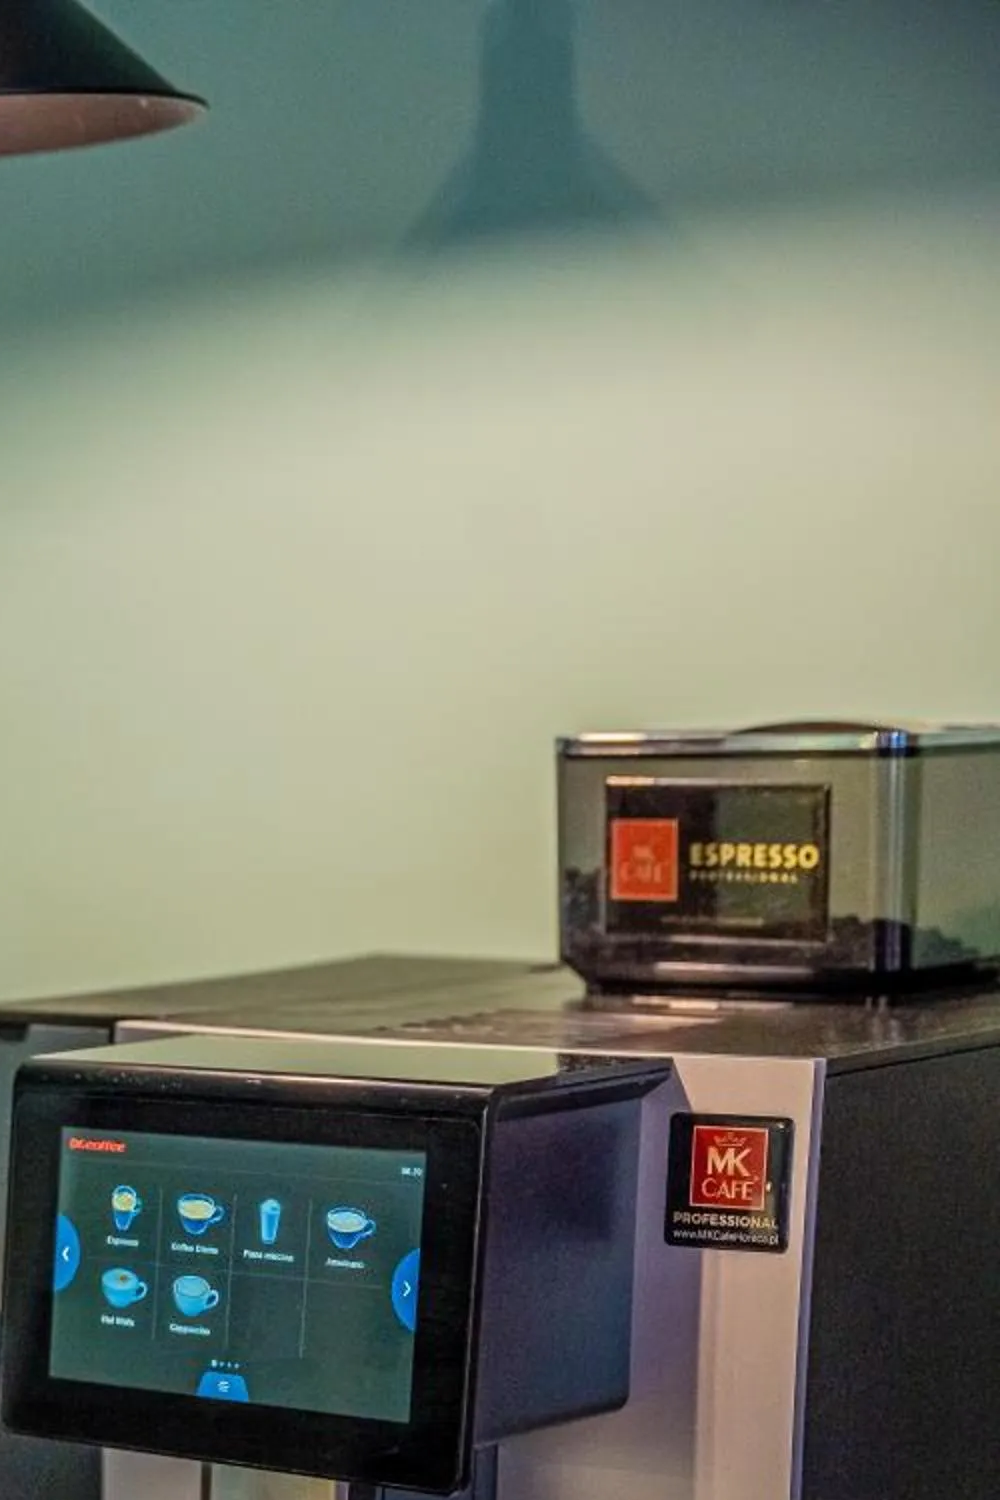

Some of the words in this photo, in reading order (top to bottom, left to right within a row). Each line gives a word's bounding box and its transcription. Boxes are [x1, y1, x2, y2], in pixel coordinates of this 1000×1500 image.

[690, 843, 819, 868] ESPRESSO
[706, 1146, 752, 1177] MK
[673, 1212, 778, 1229] PROFESSIONAL
